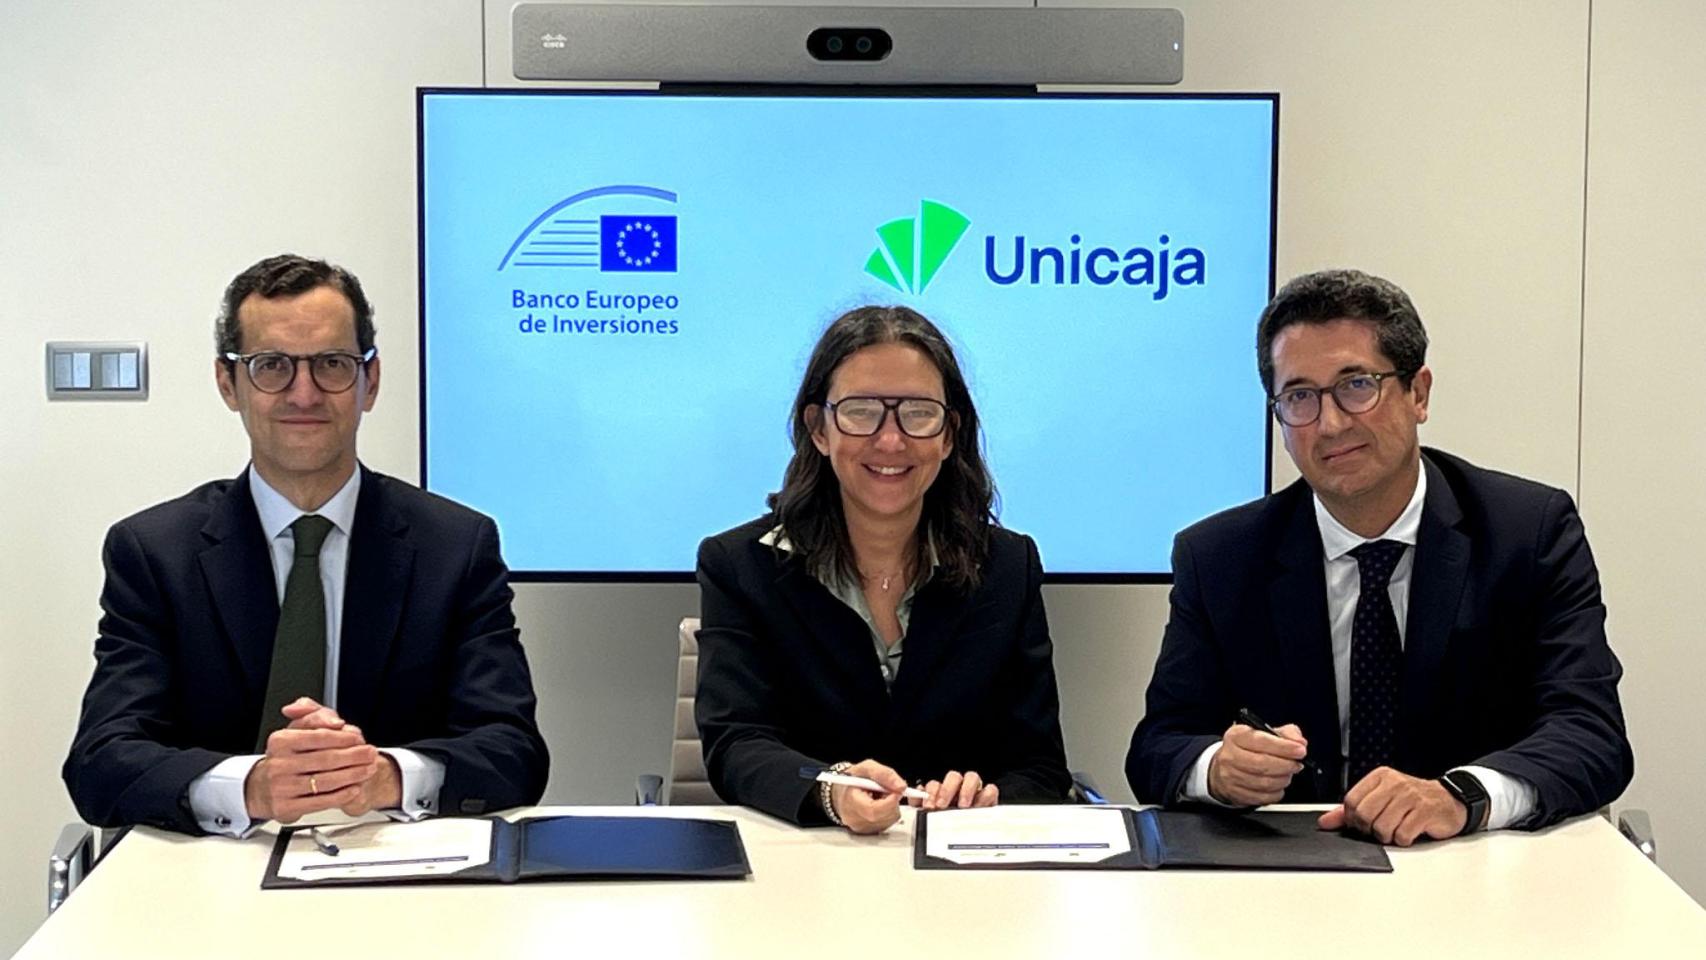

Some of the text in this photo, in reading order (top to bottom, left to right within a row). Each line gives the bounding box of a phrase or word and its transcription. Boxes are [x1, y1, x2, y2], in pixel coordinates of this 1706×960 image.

[985, 234, 1206, 301] Unicaja
[512, 289, 679, 314] Banco Europeo
[519, 313, 679, 333] de Inversiones
